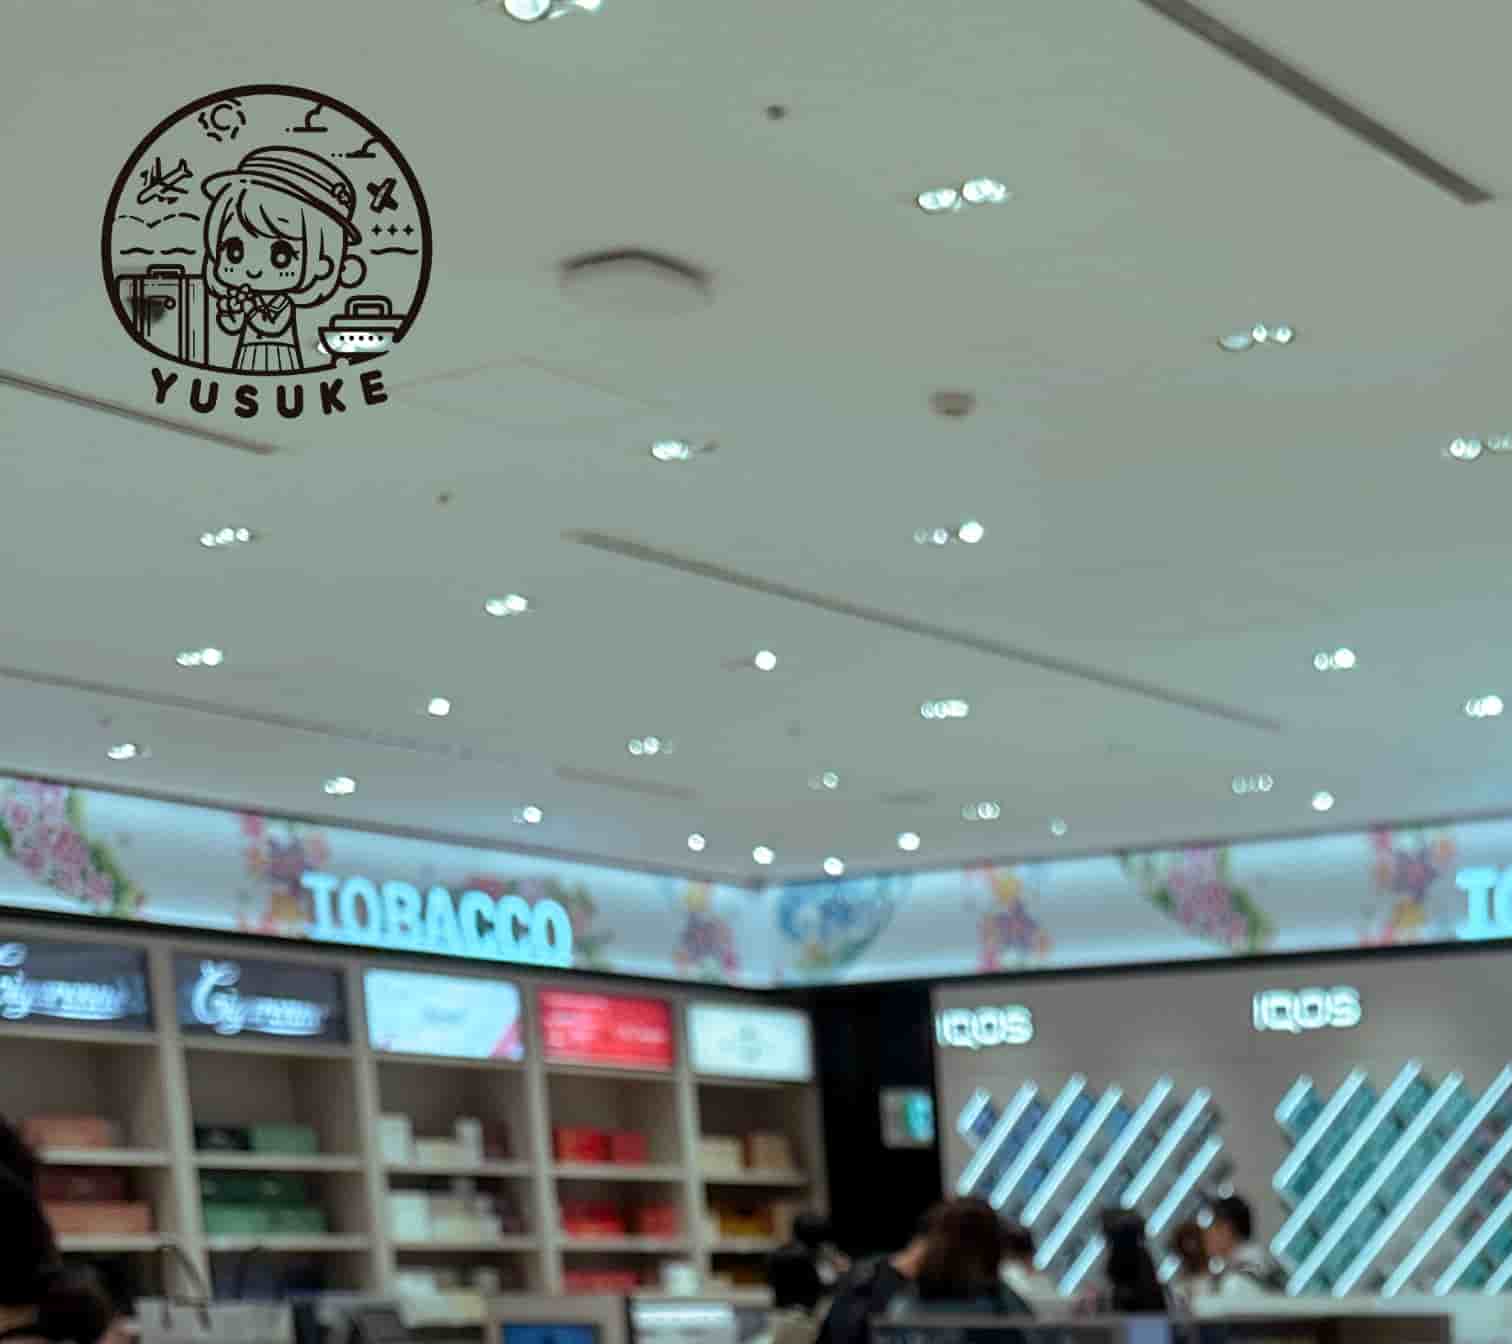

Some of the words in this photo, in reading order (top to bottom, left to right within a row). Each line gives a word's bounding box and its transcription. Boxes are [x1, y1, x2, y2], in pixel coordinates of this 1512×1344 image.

[302, 871, 573, 968] TOBACCO
[936, 1005, 1034, 1050] IQOS
[1253, 985, 1361, 1034] IQOS
